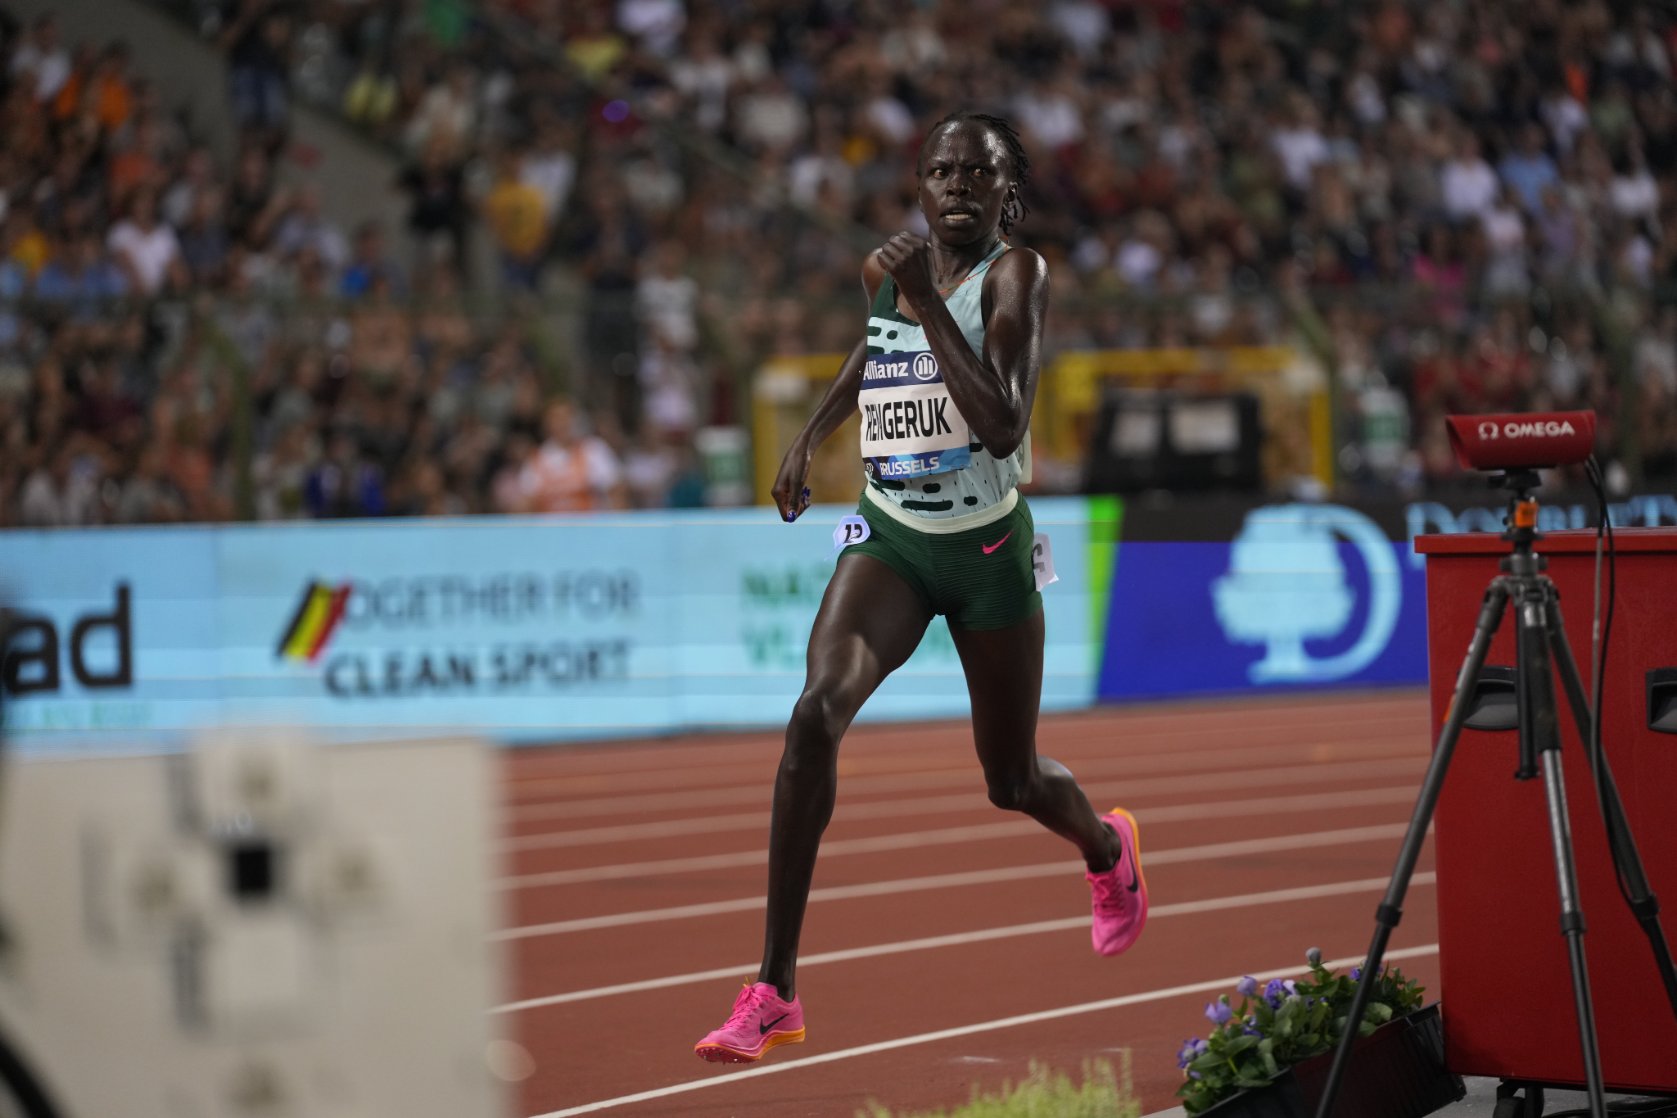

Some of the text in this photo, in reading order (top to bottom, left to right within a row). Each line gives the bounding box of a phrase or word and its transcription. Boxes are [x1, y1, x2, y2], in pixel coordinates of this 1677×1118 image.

[863, 360, 909, 381] Allianz
[864, 397, 953, 442] RENGERUK
[1503, 420, 1575, 439] OMEGA
[879, 456, 940, 477] BRUSSELS
[553, 569, 642, 624] FOR
[325, 637, 632, 701] CLEAN SPORT
